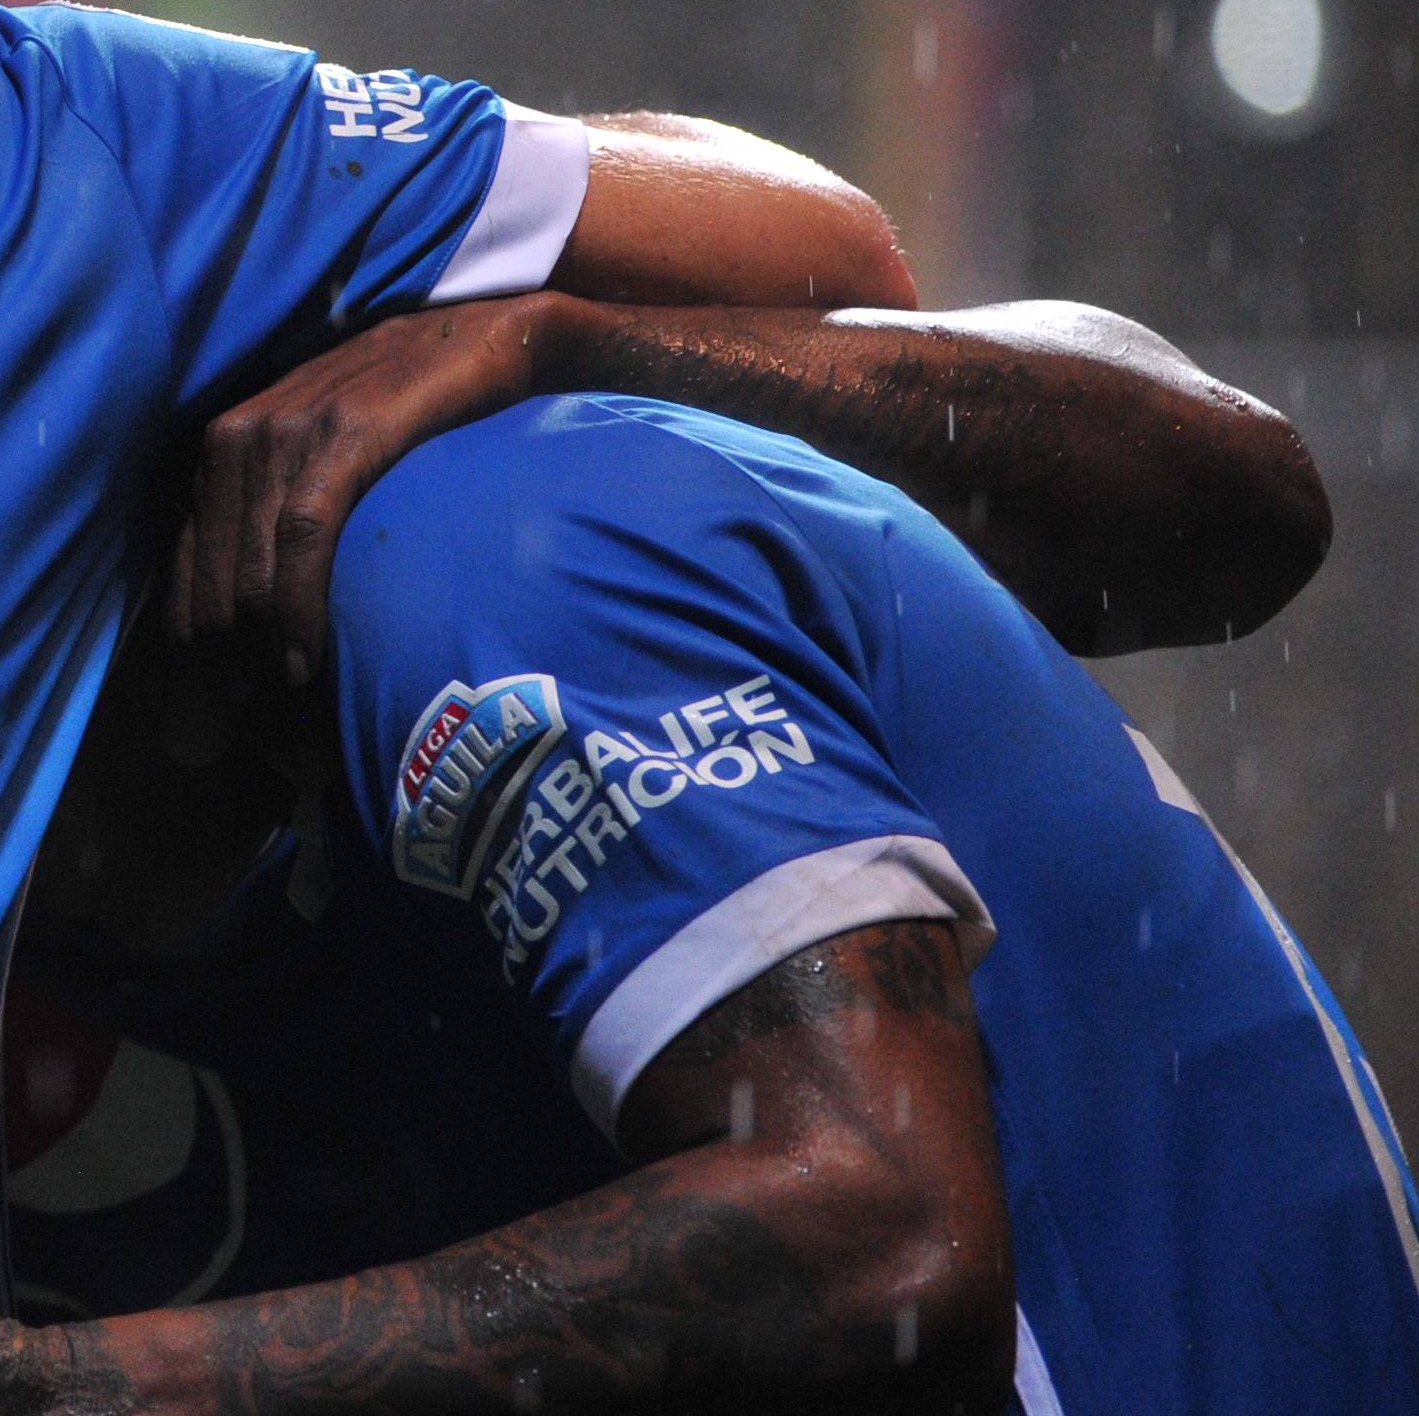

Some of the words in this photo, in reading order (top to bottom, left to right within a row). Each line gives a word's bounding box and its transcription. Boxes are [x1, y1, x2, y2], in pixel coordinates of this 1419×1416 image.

[406, 711, 461, 787] LIGA
[409, 691, 540, 879] AGUILA
[483, 673, 789, 941] HERBALIFE
